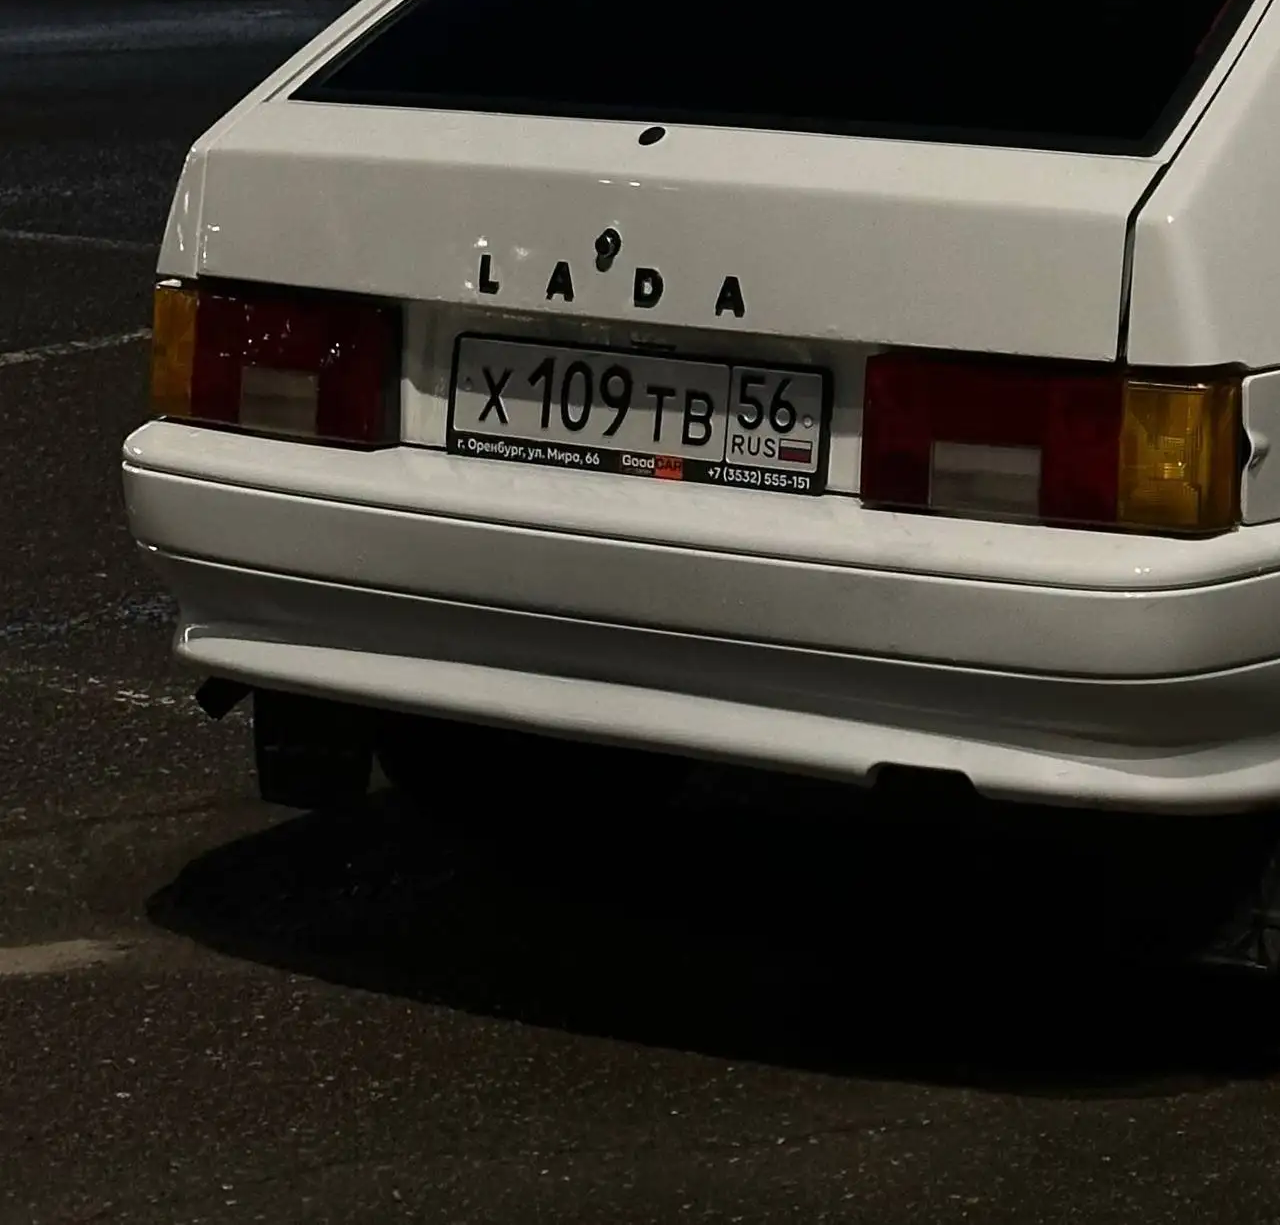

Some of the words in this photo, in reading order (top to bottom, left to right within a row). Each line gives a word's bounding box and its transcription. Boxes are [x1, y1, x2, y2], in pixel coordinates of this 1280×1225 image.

[478, 254, 745, 318] LADA
[737, 374, 797, 434] 56
[457, 438, 466, 449] г.
[467, 438, 526, 457] Оренбург,
[527, 450, 546, 461] ул.
[585, 452, 601, 466] 66
[731, 434, 776, 458] RUS
[707, 466, 721, 479] +7
[722, 467, 762, 485] (3532)
[763, 472, 811, 490] 555-151
